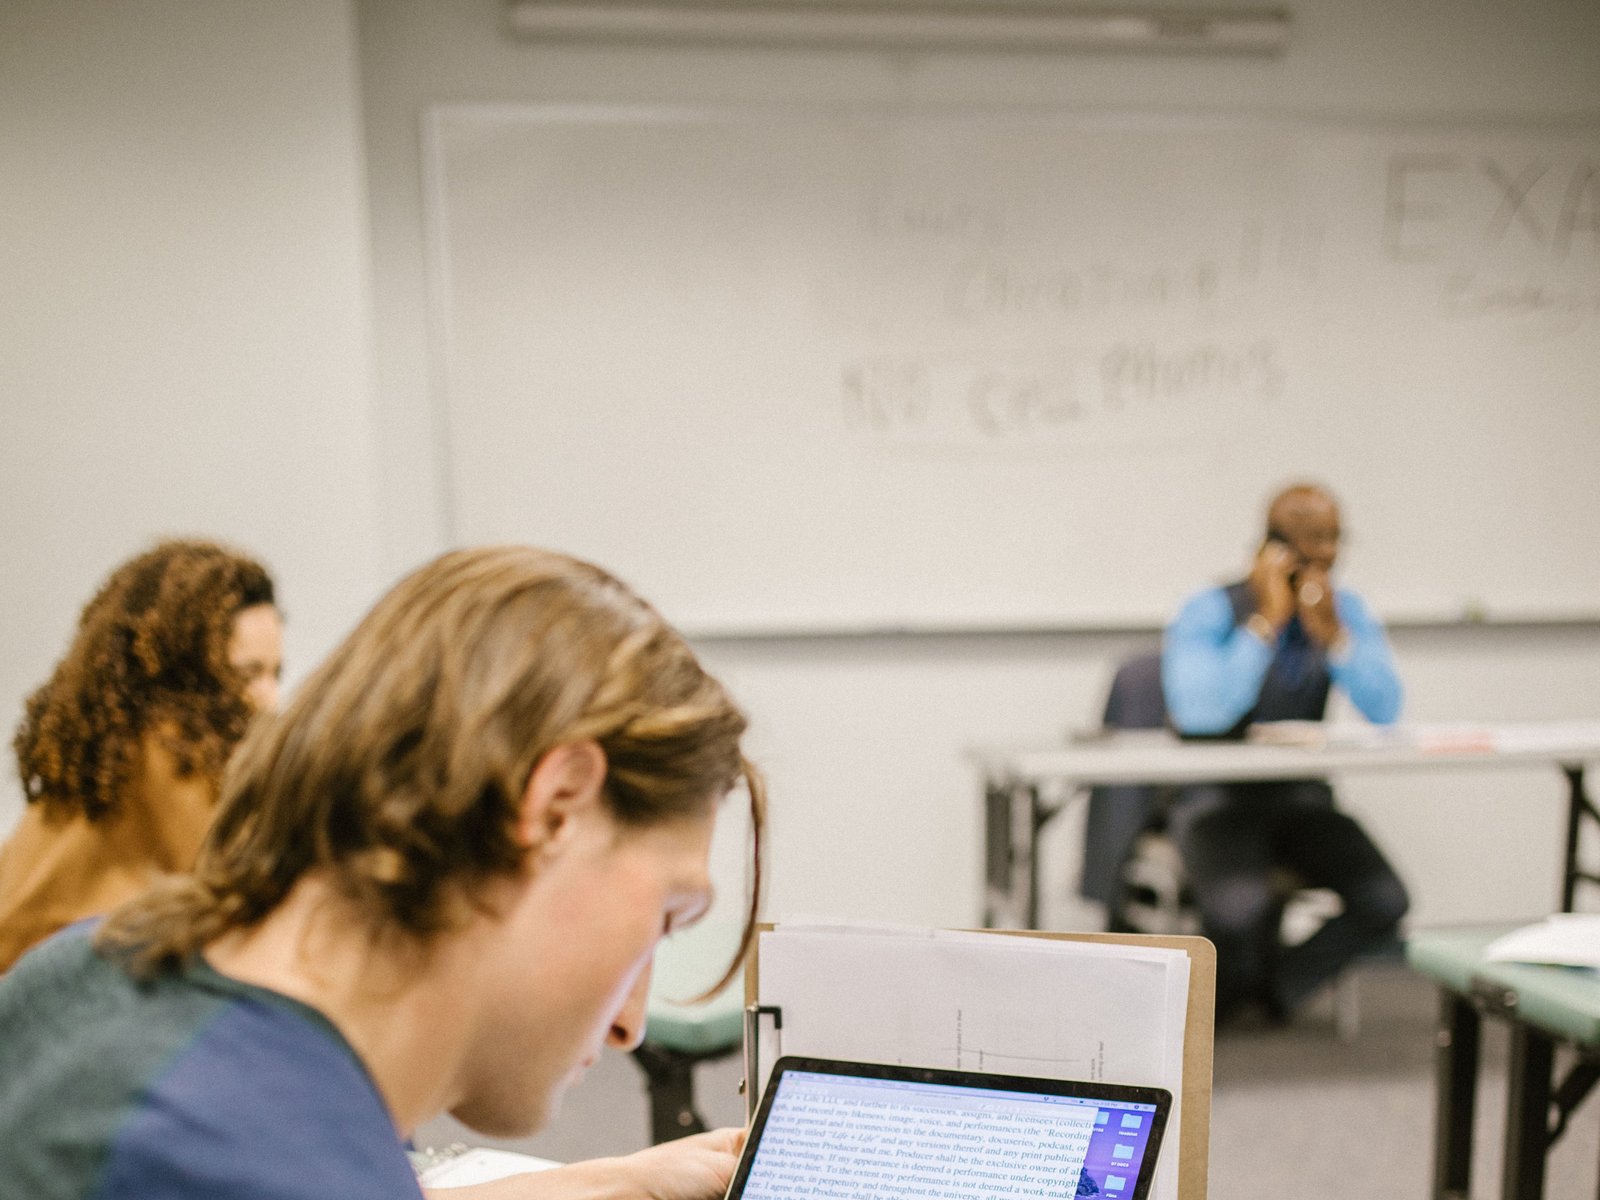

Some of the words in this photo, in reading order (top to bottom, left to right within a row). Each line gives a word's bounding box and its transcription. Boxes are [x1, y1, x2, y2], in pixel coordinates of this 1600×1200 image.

[1022, 1126, 1042, 1137] (the
[985, 1147, 1003, 1156] and
[1003, 1150, 1020, 1160] any
[1020, 1151, 1043, 1160] print
[970, 1157, 985, 1166] the
[985, 1159, 1028, 1170] exclusive
[1028, 1165, 1057, 1173] owner
[952, 1168, 1009, 1180] performance
[1009, 1174, 1036, 1183] under
[928, 1188, 943, 1197] the
[978, 1181, 1014, 1193] deemed
